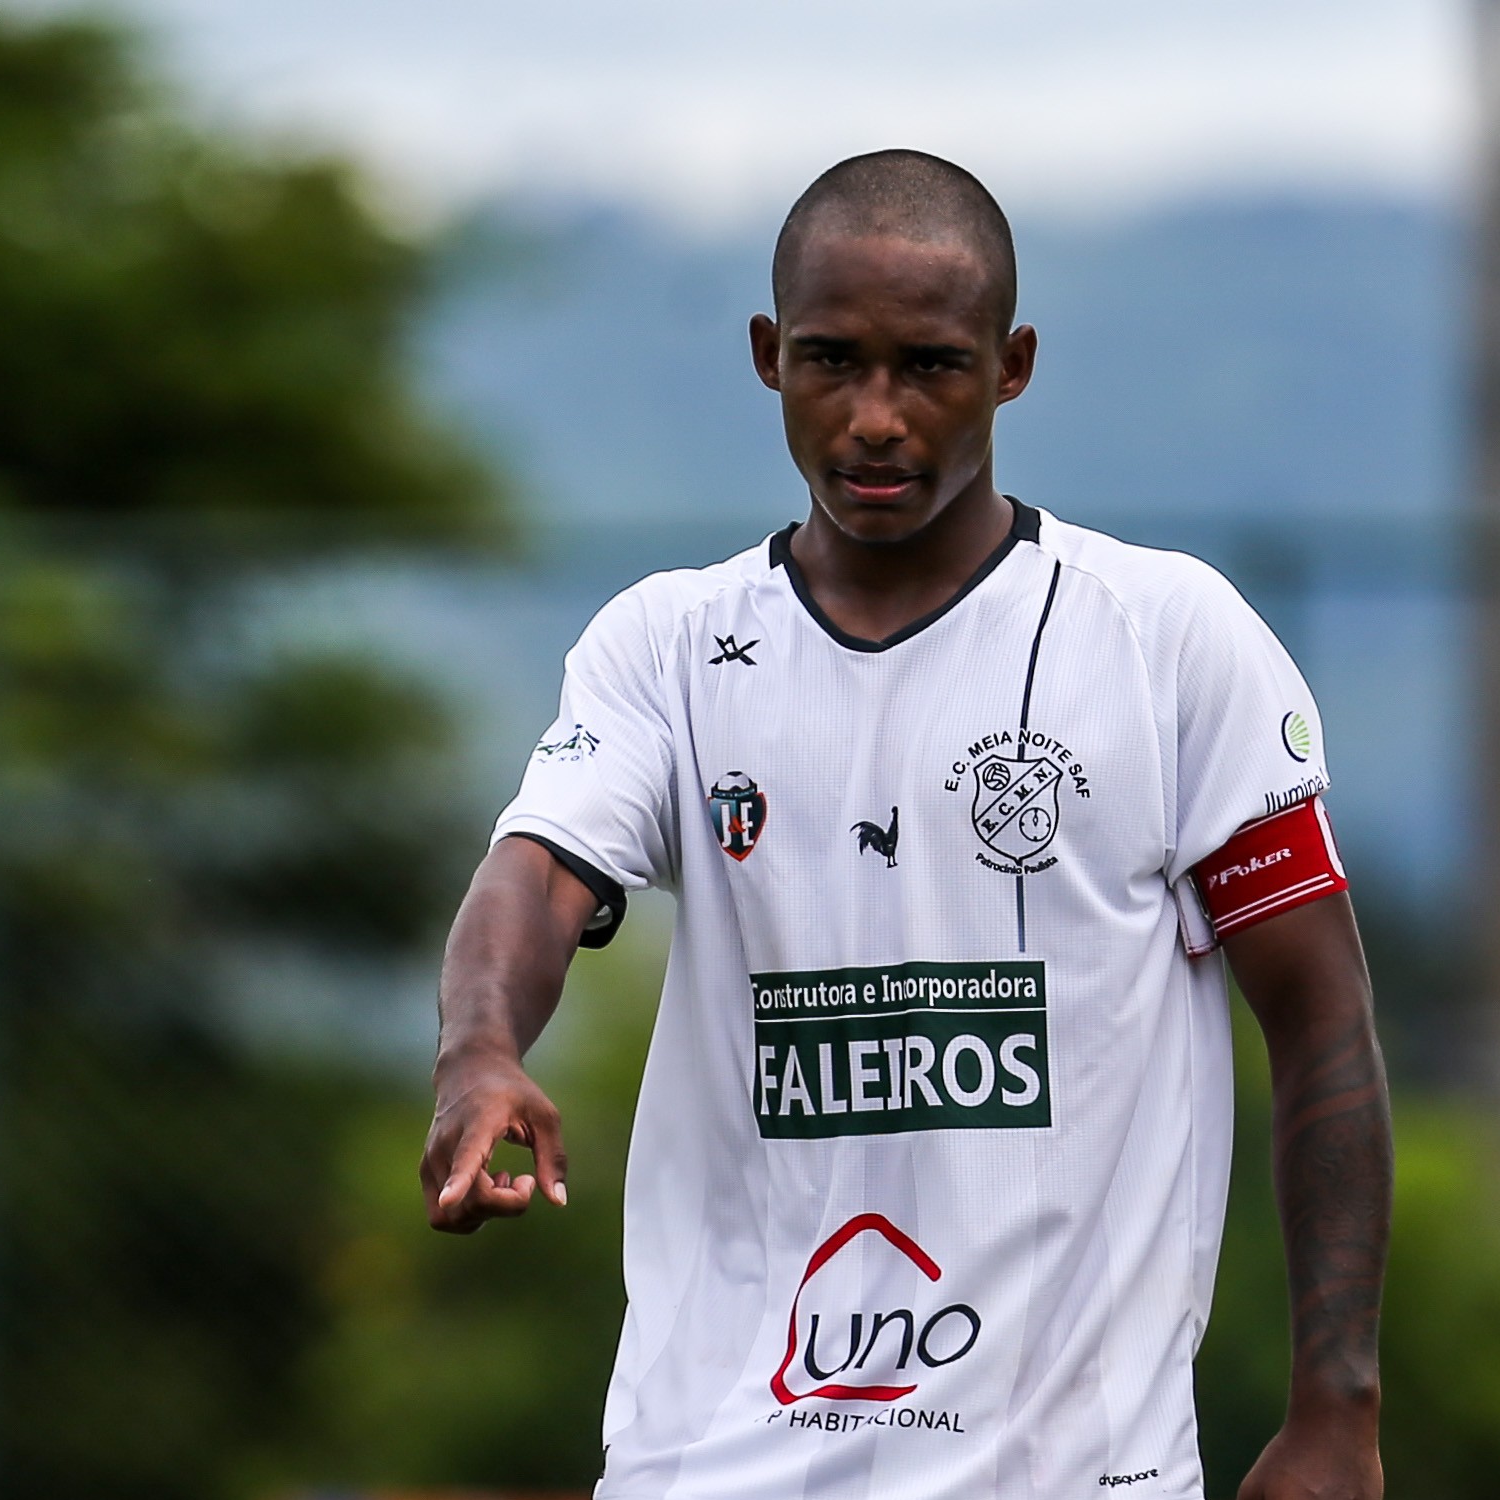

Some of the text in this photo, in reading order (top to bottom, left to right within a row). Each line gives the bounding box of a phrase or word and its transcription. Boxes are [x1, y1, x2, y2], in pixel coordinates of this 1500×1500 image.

[945, 730, 1091, 799] E.C. MEIA NOITE SAF
[863, 982, 877, 1004] e
[881, 969, 1037, 1008] Inorporadora
[759, 1032, 1041, 1116] FALEIROS
[804, 1303, 982, 1382] uno
